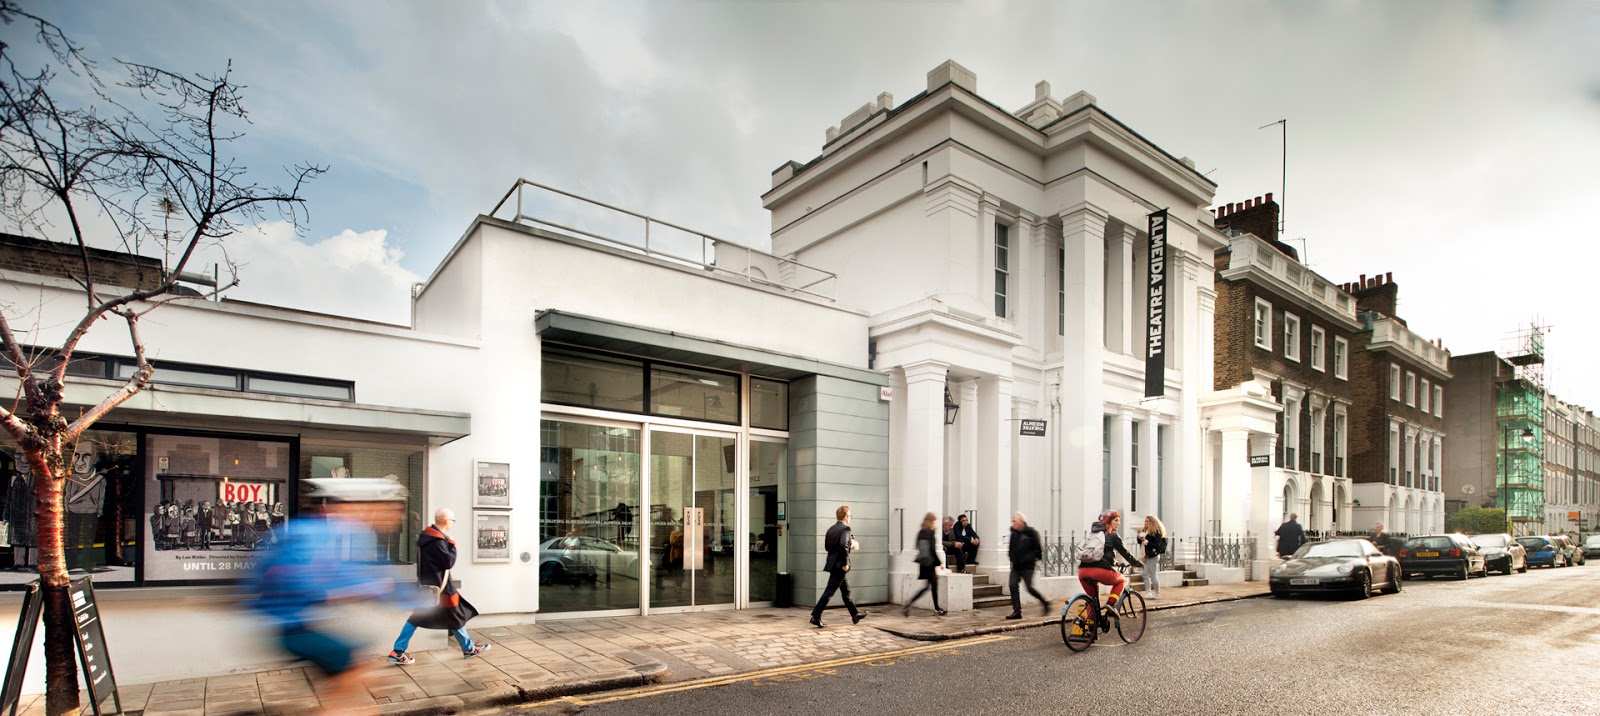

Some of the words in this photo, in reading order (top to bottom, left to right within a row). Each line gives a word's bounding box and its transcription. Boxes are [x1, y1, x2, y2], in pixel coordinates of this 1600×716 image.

[1151, 216, 1163, 283] ALMEIDA
[1149, 285, 1162, 358] THEATRE
[183, 562, 216, 571] UNTIL
[218, 562, 231, 570] 28
[233, 562, 257, 570] MAY
